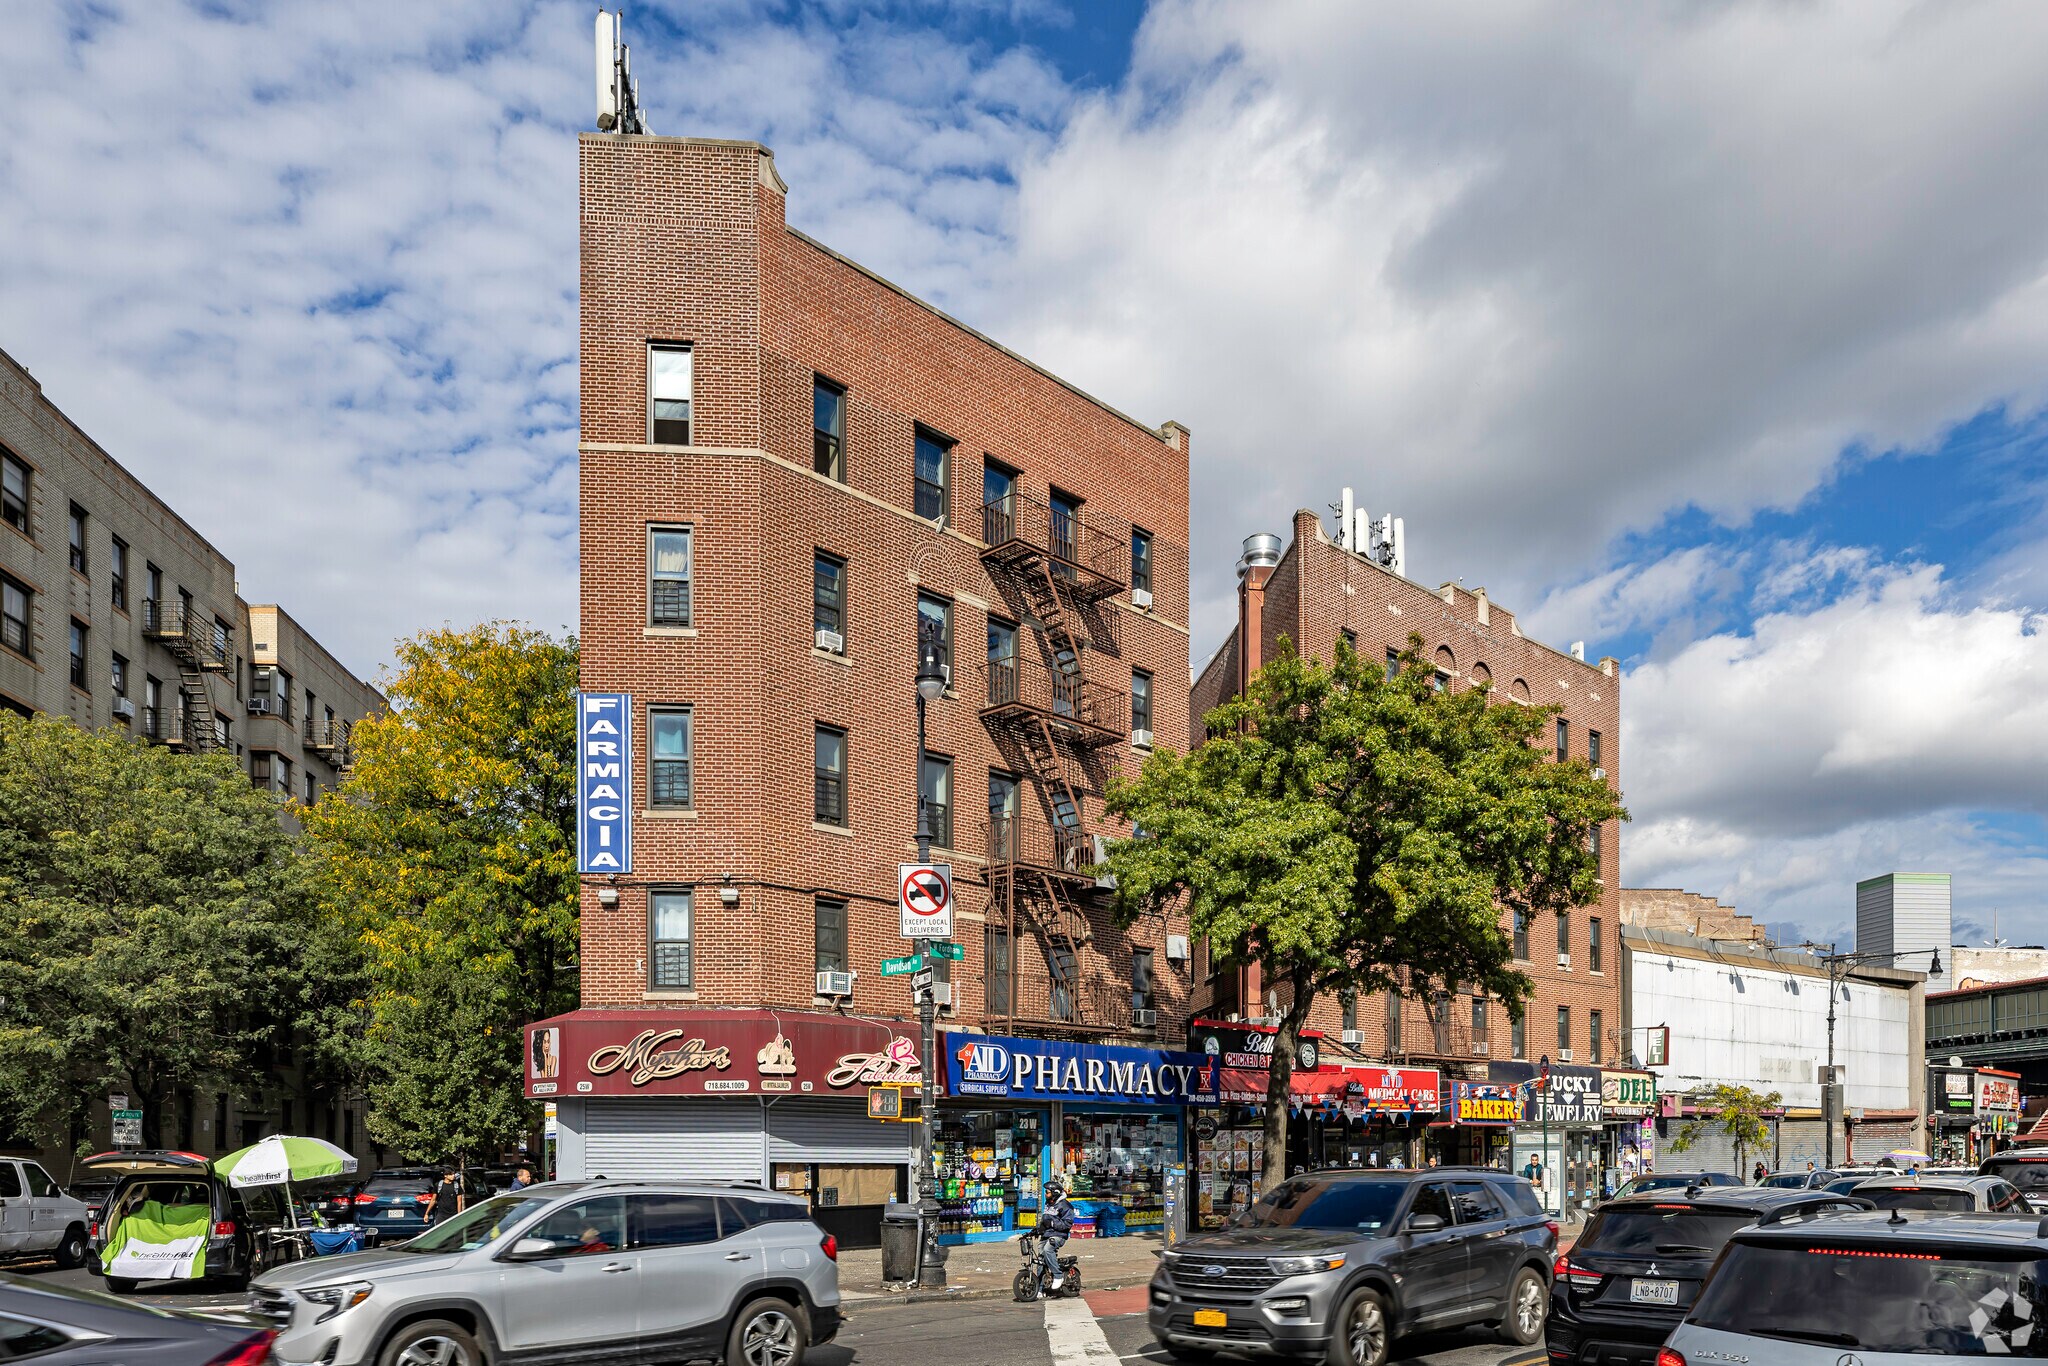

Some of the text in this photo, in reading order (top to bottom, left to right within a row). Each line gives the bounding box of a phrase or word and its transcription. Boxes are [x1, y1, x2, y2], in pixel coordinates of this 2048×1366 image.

[586, 698, 621, 867] FARMACIA
[904, 918, 948, 926] EXCEPT LOCAL
[909, 926, 943, 934] DELIVERIES
[938, 944, 960, 955] Fordham
[885, 961, 912, 974] Davidson
[1652, 1029, 1662, 1064] DELI
[587, 1029, 731, 1085] Myrtha's
[1225, 1052, 1259, 1068] CHICKEN
[966, 1071, 1001, 1080] PHARMACY
[1012, 1053, 1193, 1096] PHARMACY
[707, 1082, 736, 1090] 718.684.1009
[960, 1083, 1008, 1095] SURGICAL SUPPLIES
[1618, 1077, 1657, 1102] DELI
[1535, 1103, 1602, 1122] JEWELRY
[1019, 1118, 1038, 1129] 23 W
[244, 1172, 281, 1183] healthfirst
[1694, 1350, 1749, 1364] GLK 350
